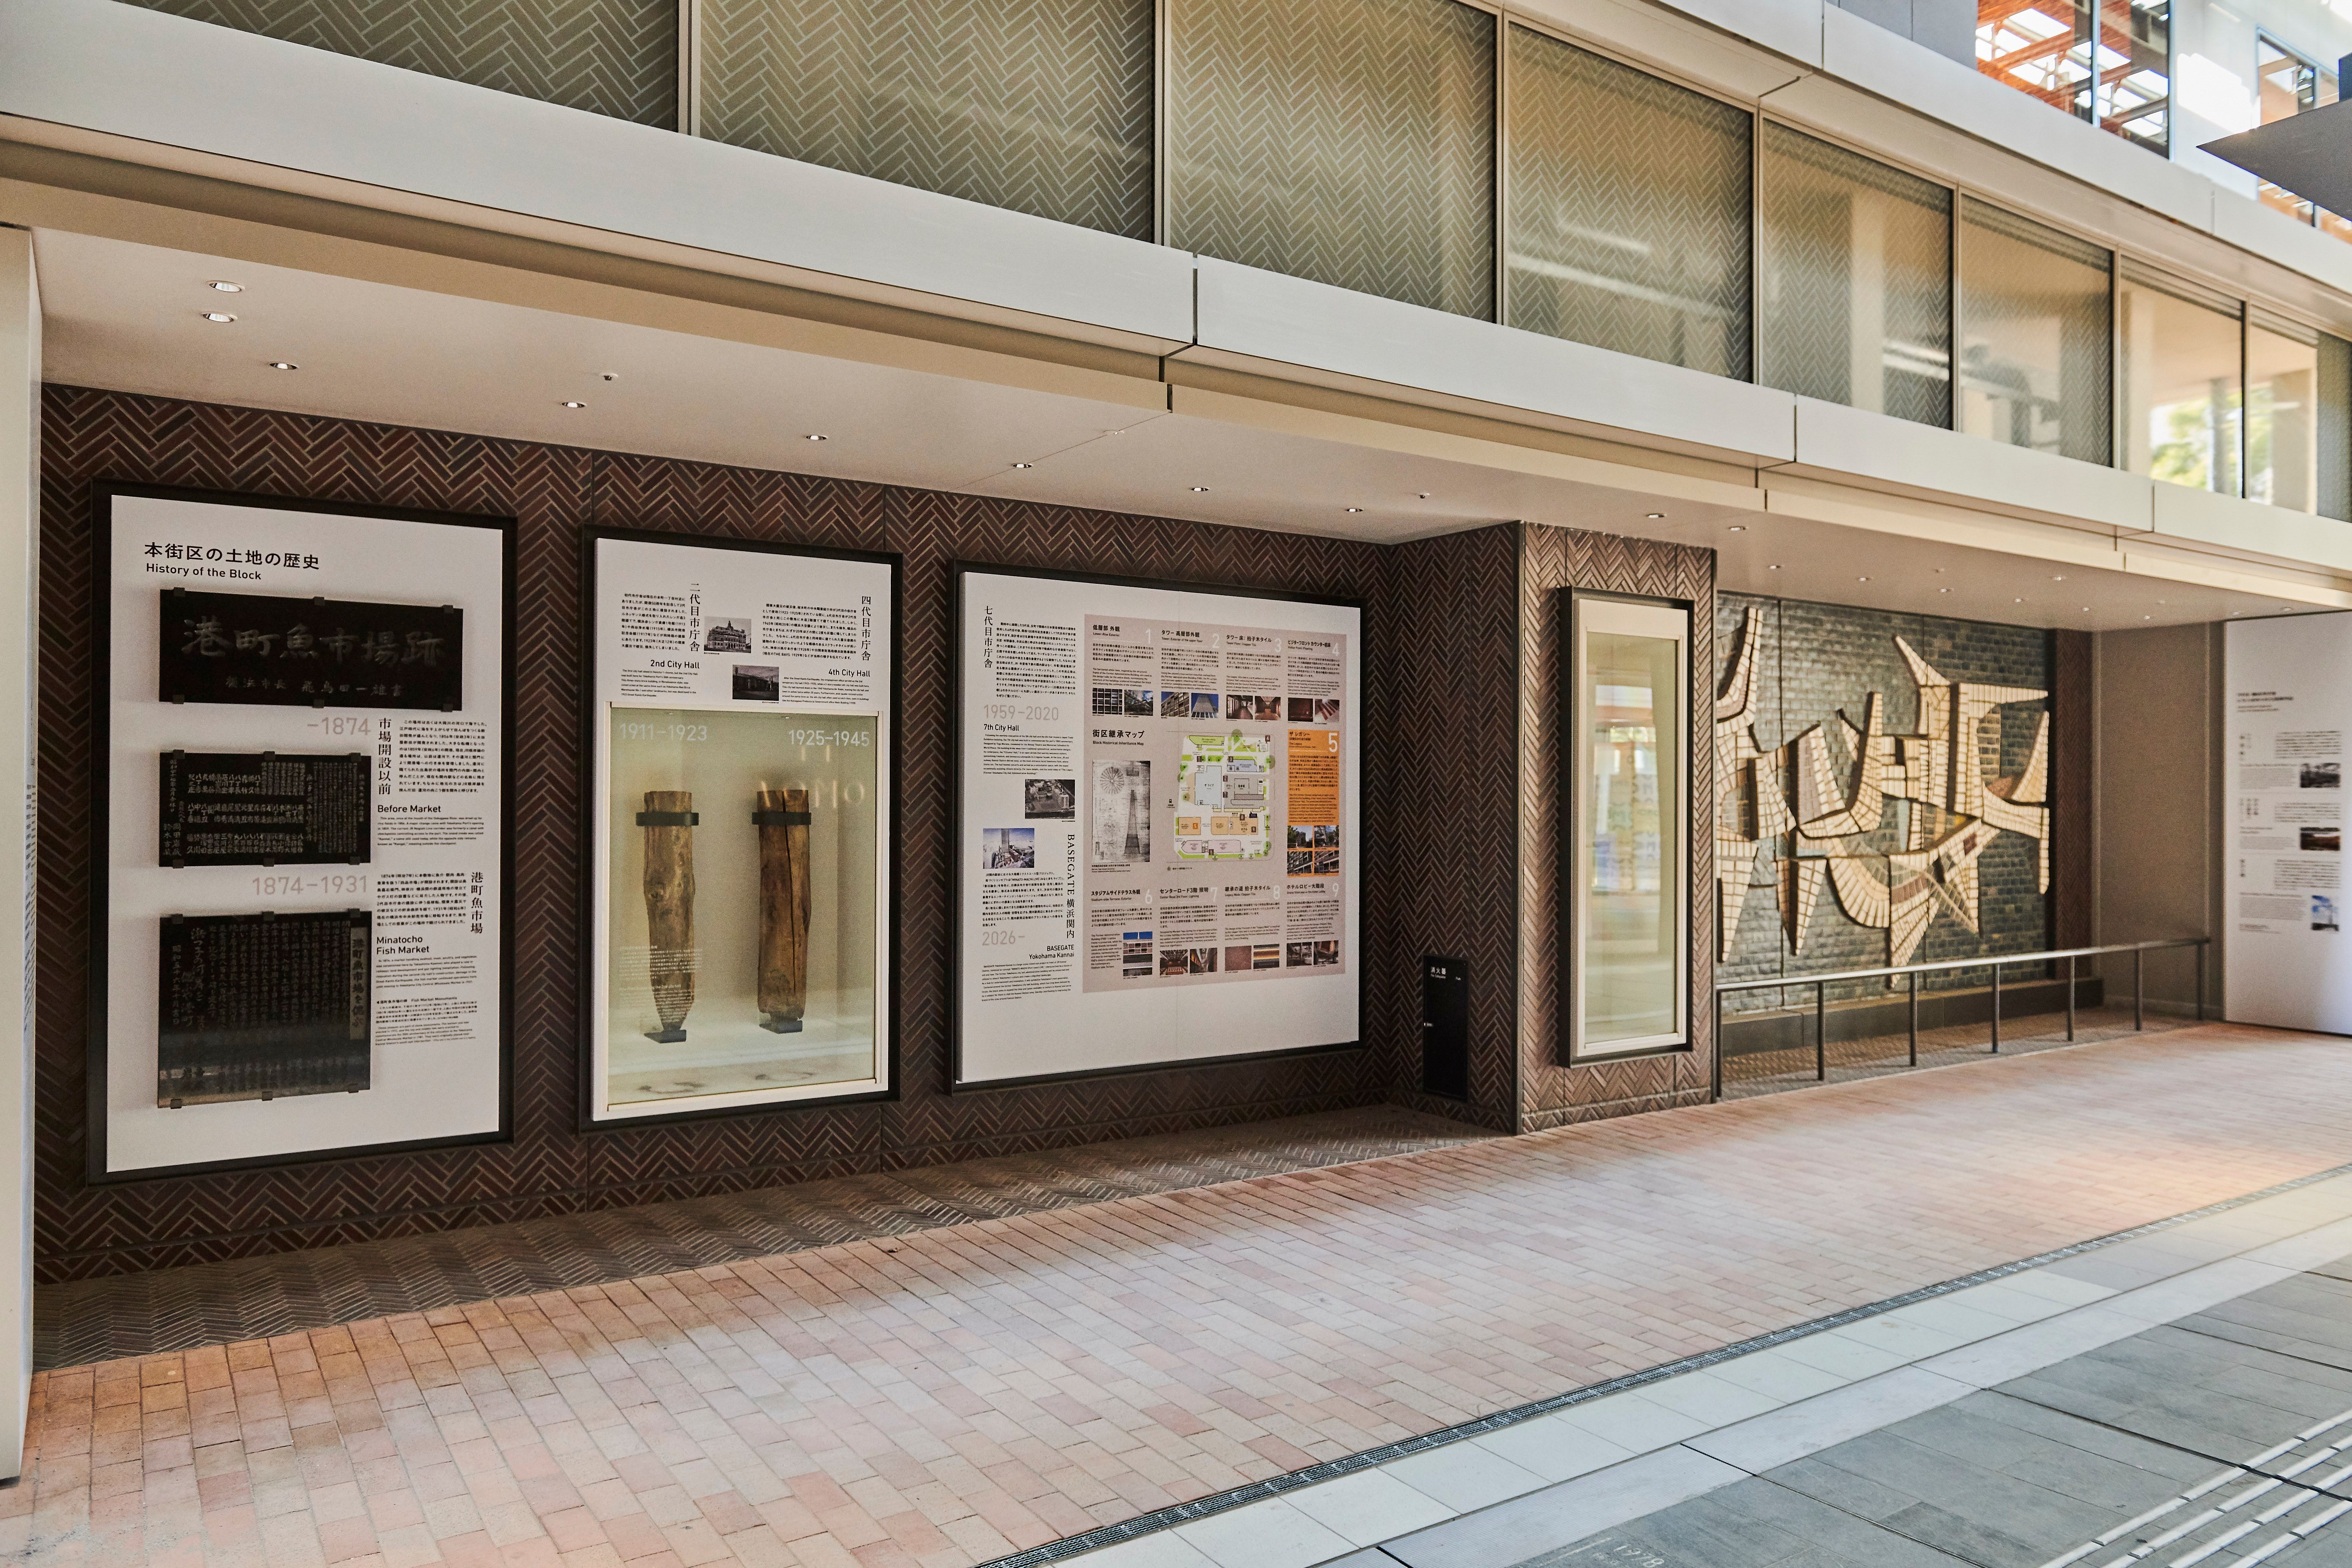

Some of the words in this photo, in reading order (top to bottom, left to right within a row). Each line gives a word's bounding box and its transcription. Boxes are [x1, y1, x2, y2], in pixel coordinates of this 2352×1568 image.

[145, 542, 319, 570] 本街区の土地の歴史
[146, 563, 189, 577] History
[193, 566, 204, 576] of
[207, 567, 226, 577] the
[229, 569, 261, 580] Block
[689, 583, 700, 652] 二代目市庁舎
[861, 596, 871, 661] 四代目市庁舎
[984, 605, 993, 668] 七代目市庁舎
[1146, 629, 1151, 644] 1
[1212, 633, 1219, 648] 2
[1275, 638, 1281, 653] 3
[1332, 642, 1339, 657] 4
[667, 661, 682, 669] City
[984, 704, 1059, 721] 1959-2020
[789, 730, 869, 746] 1925-1945
[1092, 729, 1144, 738] 街区継承マップ
[1328, 732, 1338, 752] 5
[378, 718, 392, 795] 市場開設以前
[377, 805, 408, 813] Before
[1145, 889, 1152, 904] 6
[1273, 885, 1280, 900] 8
[1332, 883, 1339, 897] 9
[471, 871, 484, 934] 港町魚市場
[1066, 899, 1075, 939] 横浜関内
[376, 936, 423, 945] Minatocho
[376, 946, 396, 955] Fish
[398, 945, 430, 954] Market
